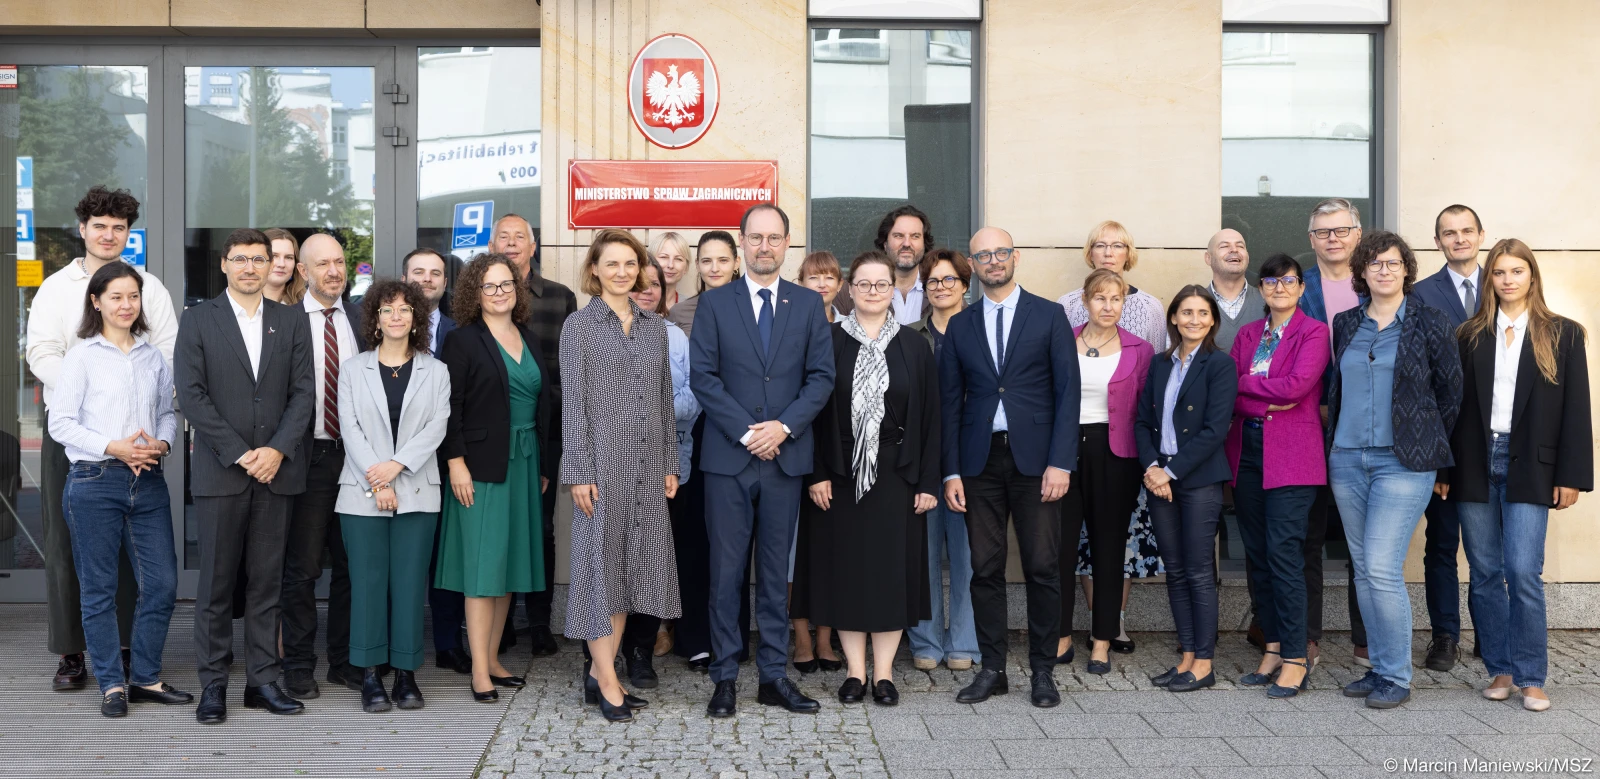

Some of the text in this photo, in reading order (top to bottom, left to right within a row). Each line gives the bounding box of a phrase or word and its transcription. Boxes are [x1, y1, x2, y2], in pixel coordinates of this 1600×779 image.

[575, 187, 772, 201] MINISTERSTWO SPRAW ZAGRANICZNYCH
